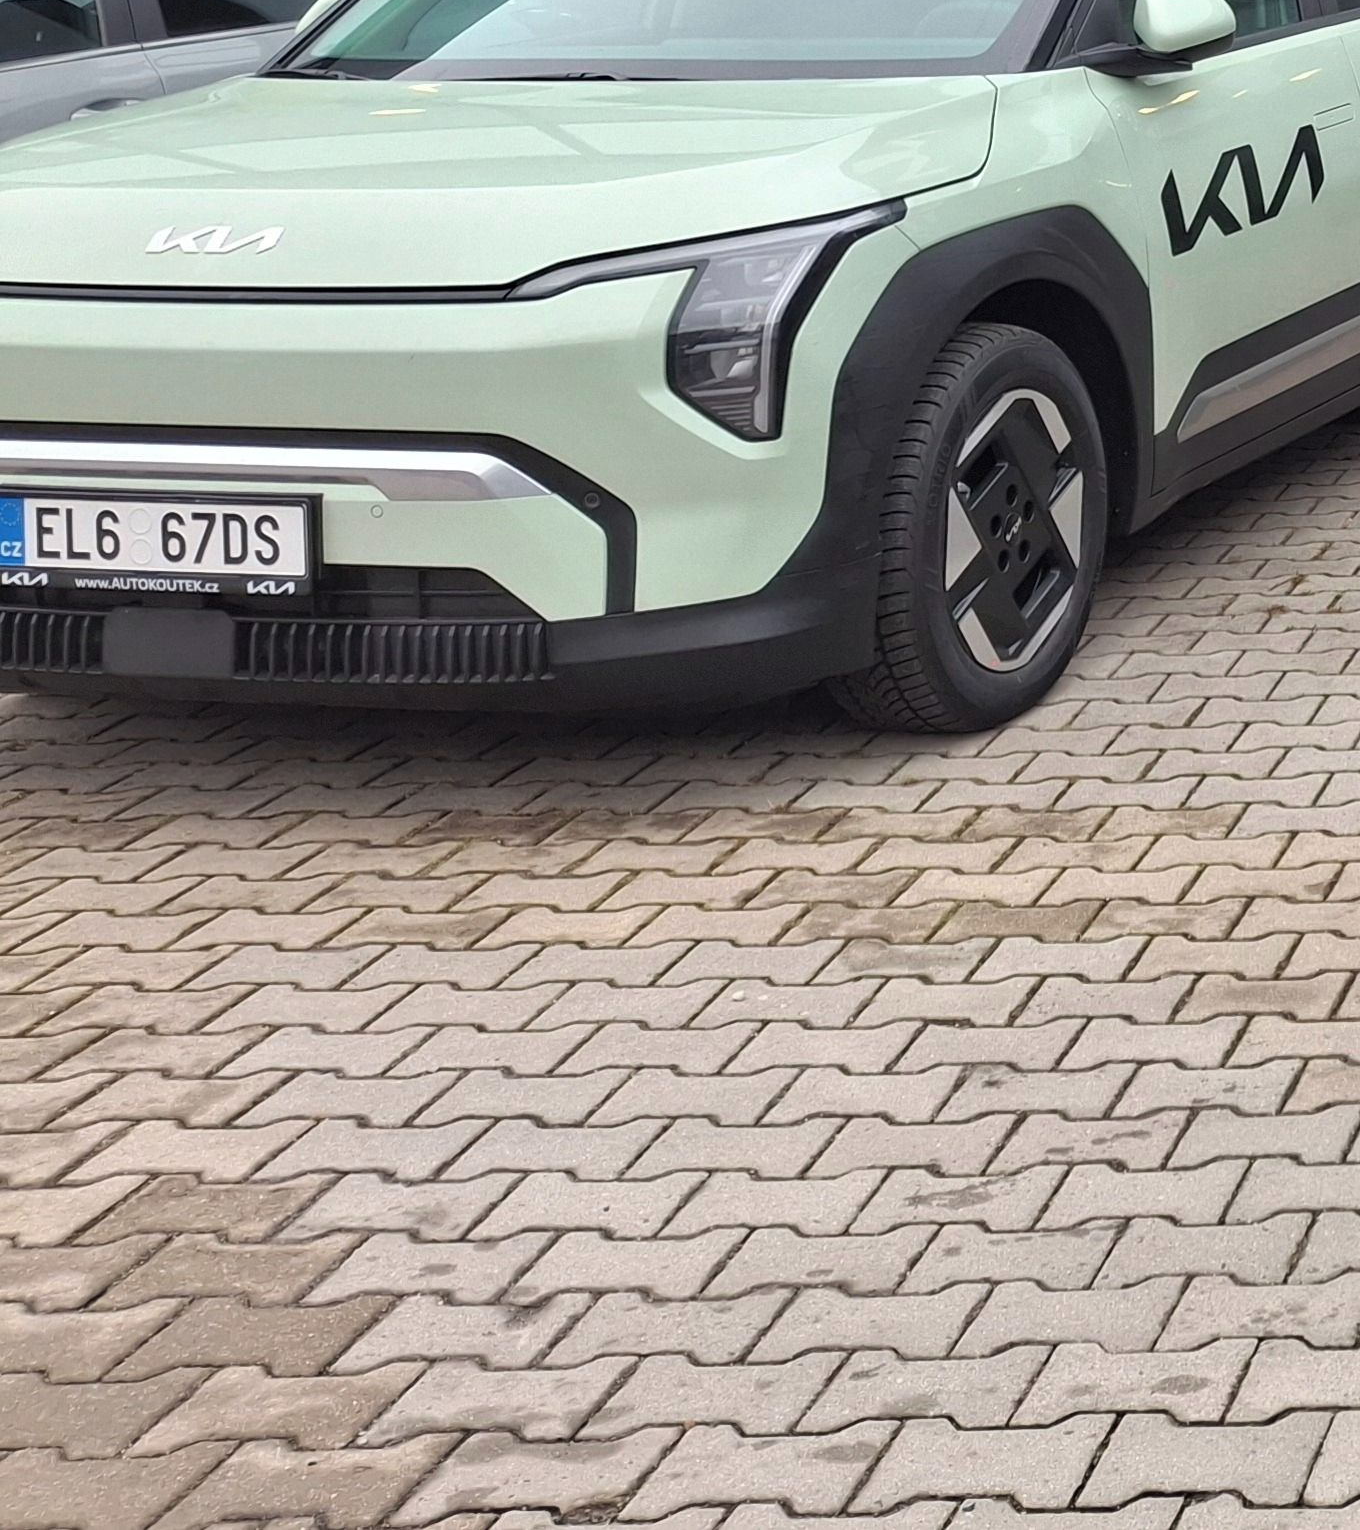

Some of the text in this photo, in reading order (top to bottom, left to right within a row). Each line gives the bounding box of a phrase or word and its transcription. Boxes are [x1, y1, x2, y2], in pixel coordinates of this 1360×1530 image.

[1161, 124, 1325, 256] KIA
[145, 224, 286, 254] KIA
[1, 540, 22, 557] CZ
[36, 507, 280, 566] EL6 67DS
[2, 572, 296, 596] KIA www.AUTOKOUTEK.cz KIA
